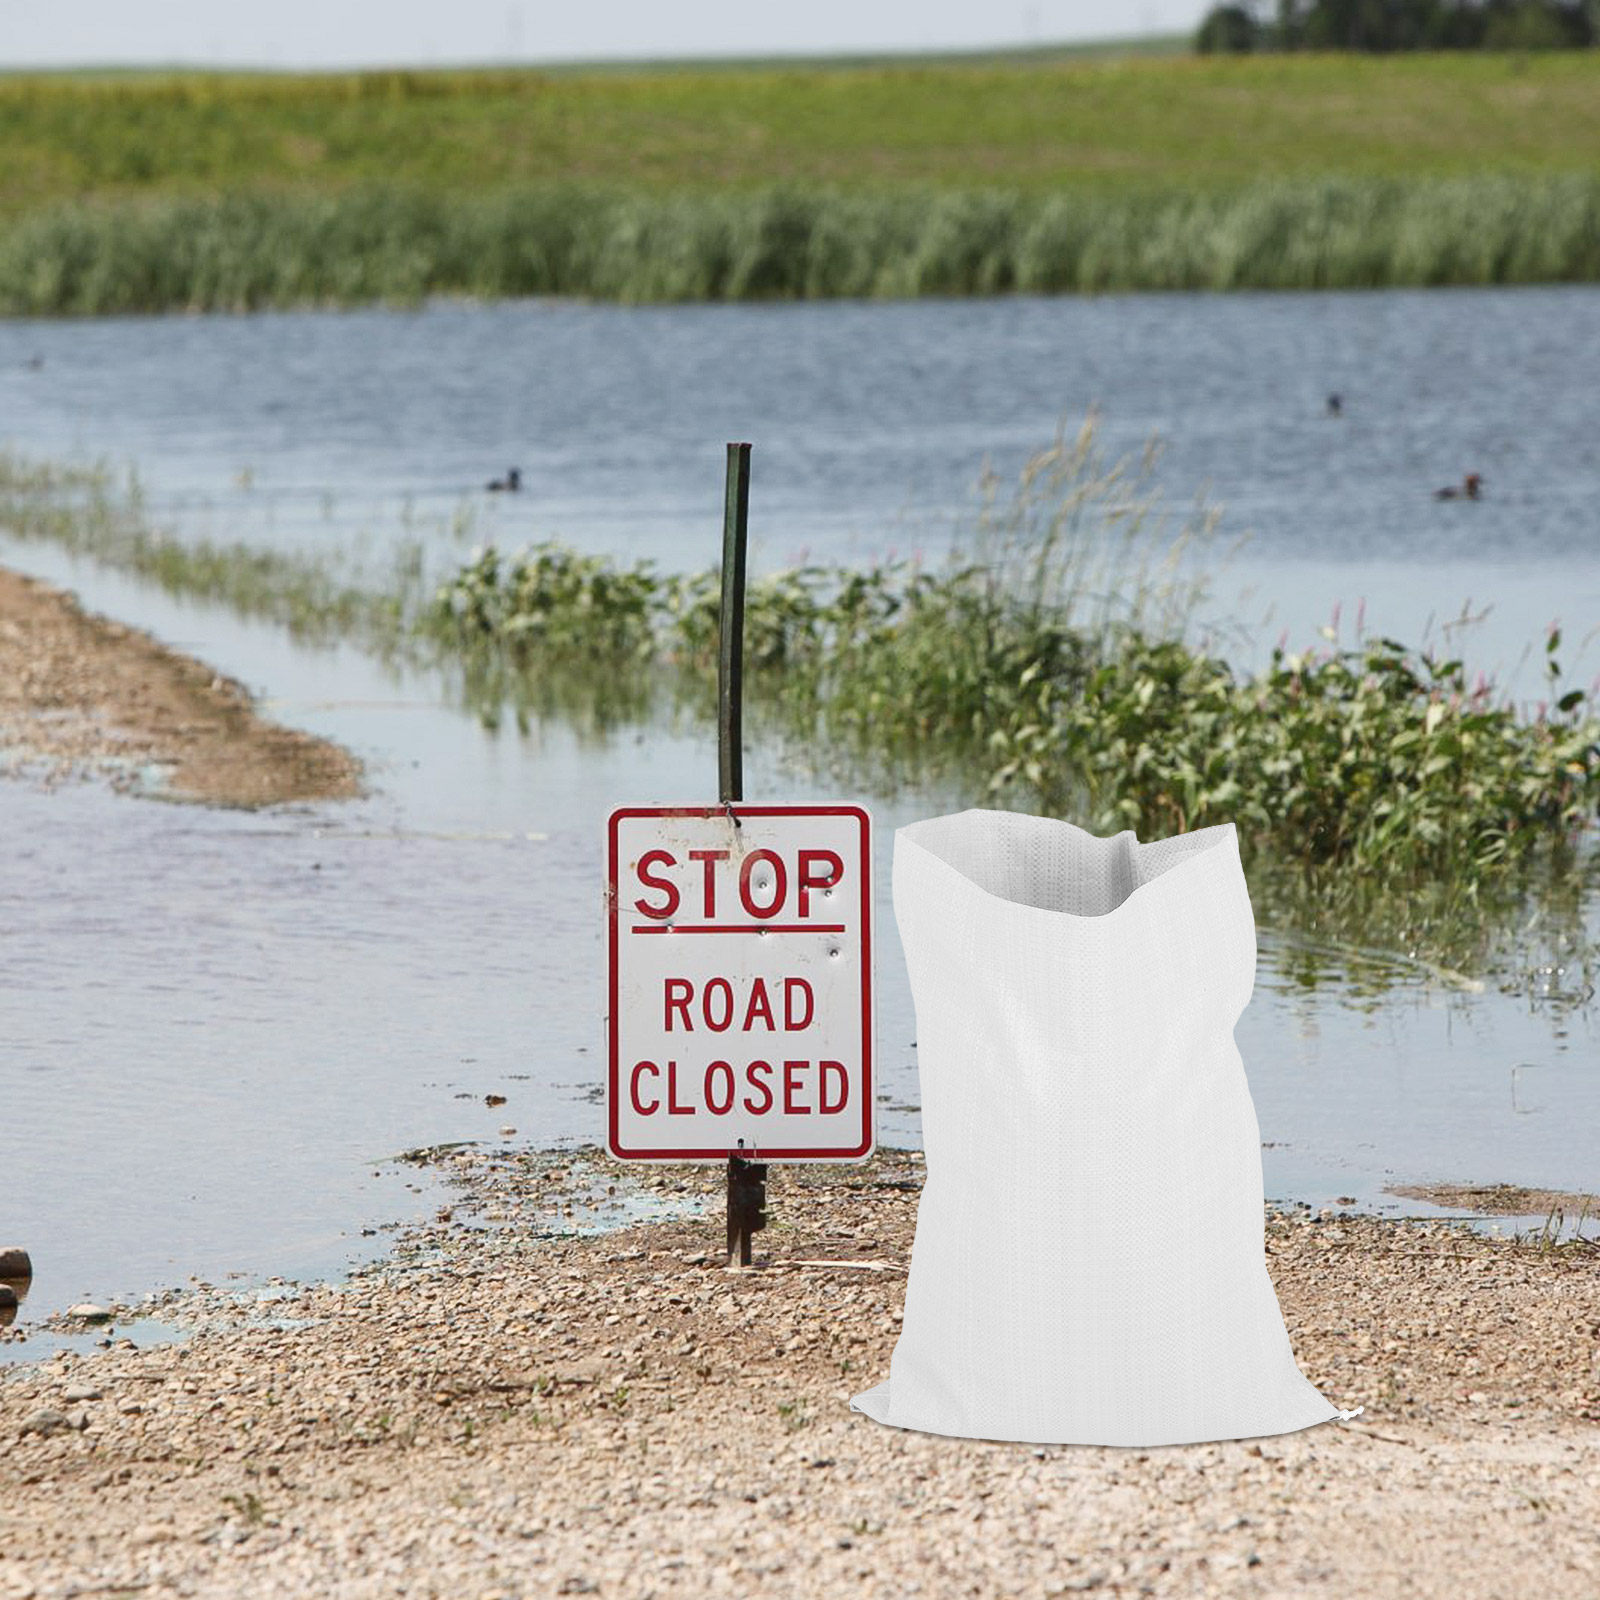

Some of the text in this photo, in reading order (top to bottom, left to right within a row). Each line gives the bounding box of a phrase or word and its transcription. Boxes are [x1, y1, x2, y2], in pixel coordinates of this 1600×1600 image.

[634, 848, 846, 920] STOP
[663, 976, 815, 1034] ROAD
[629, 1059, 850, 1117] CLOSED
